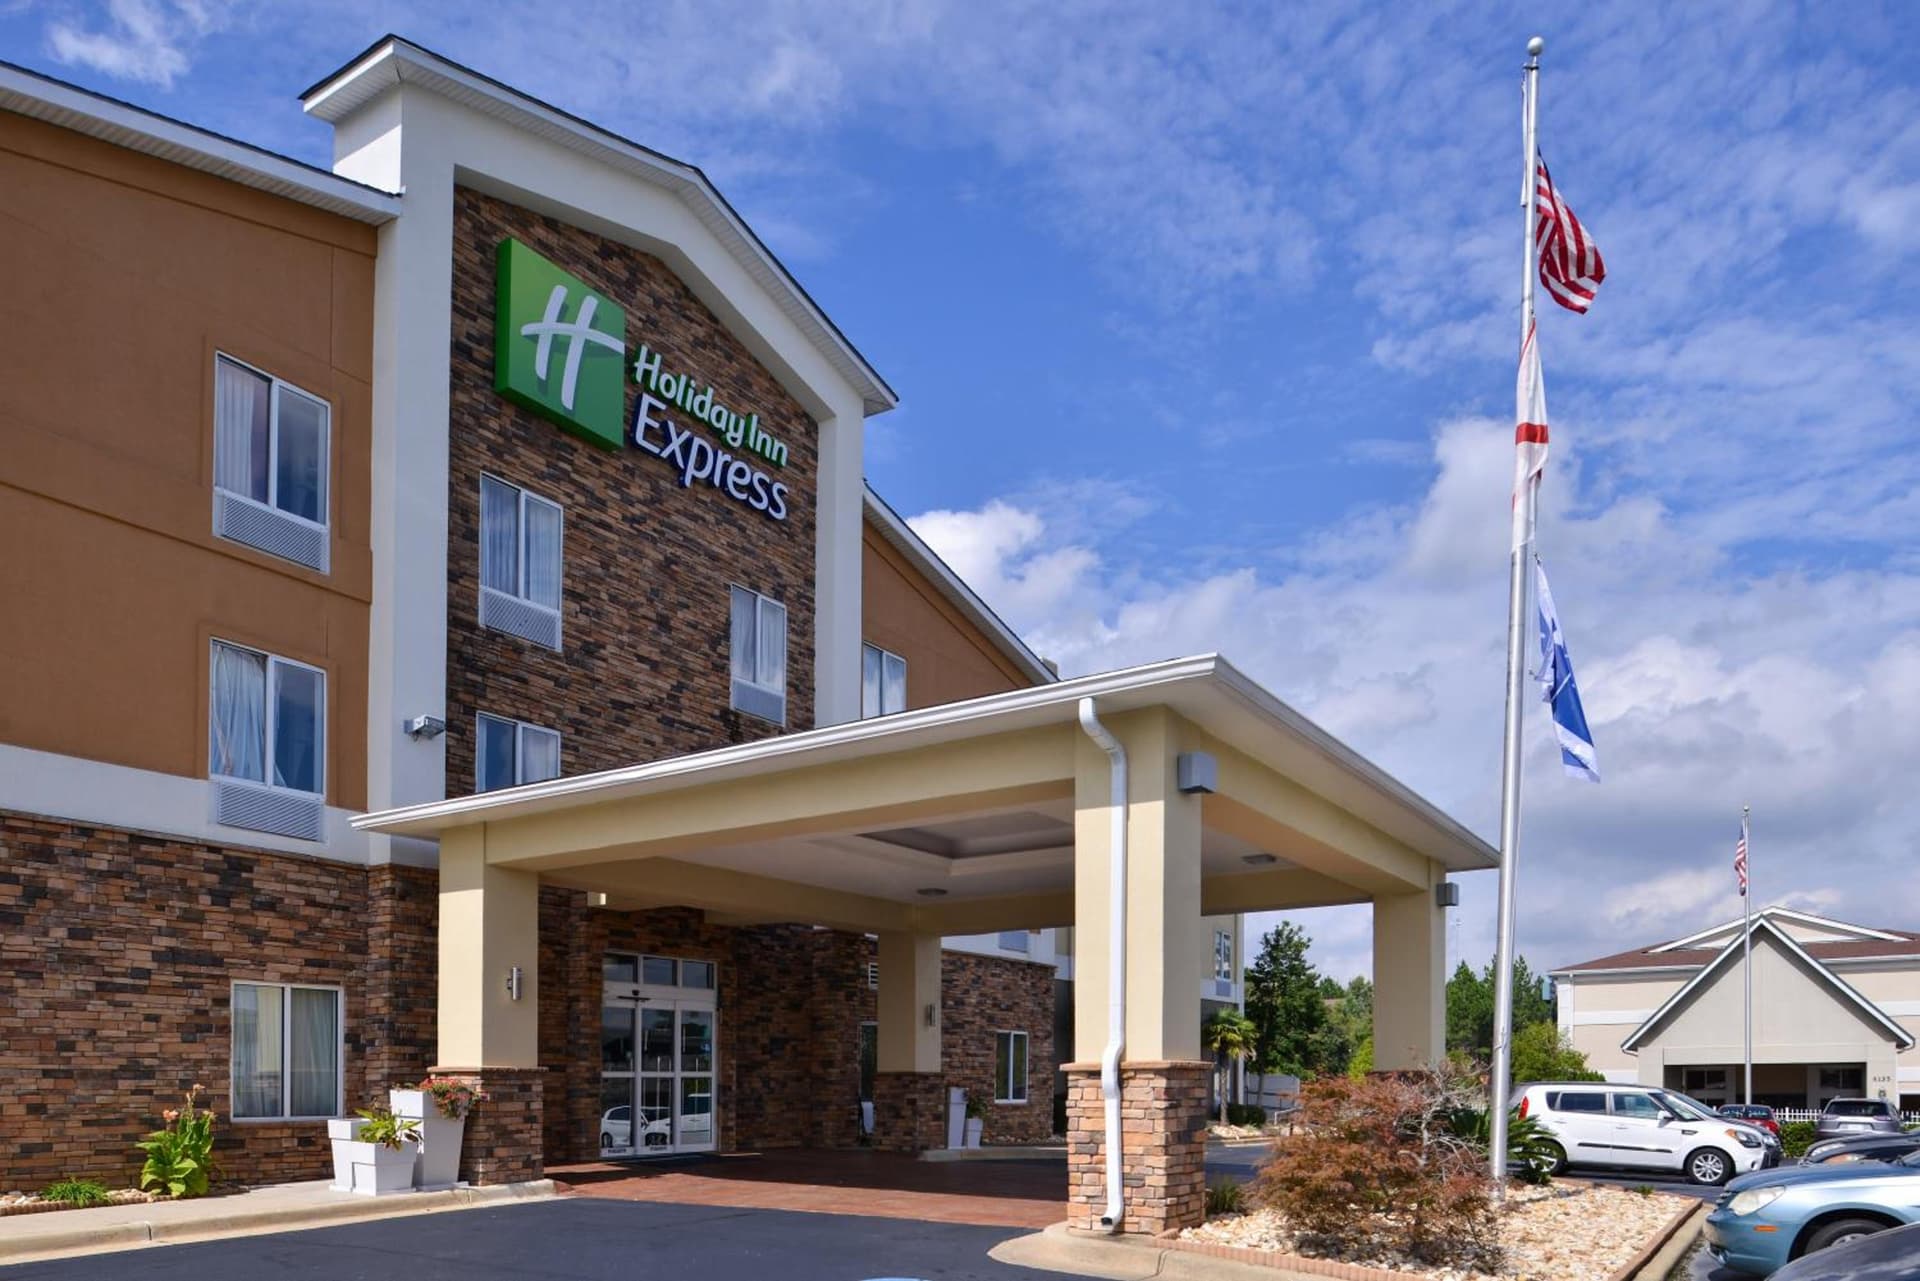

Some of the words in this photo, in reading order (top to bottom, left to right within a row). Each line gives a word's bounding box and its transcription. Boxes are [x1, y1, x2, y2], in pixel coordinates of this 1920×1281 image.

[633, 344, 746, 448] Holiday
[747, 413, 789, 467] Inn
[634, 392, 790, 521] Express
